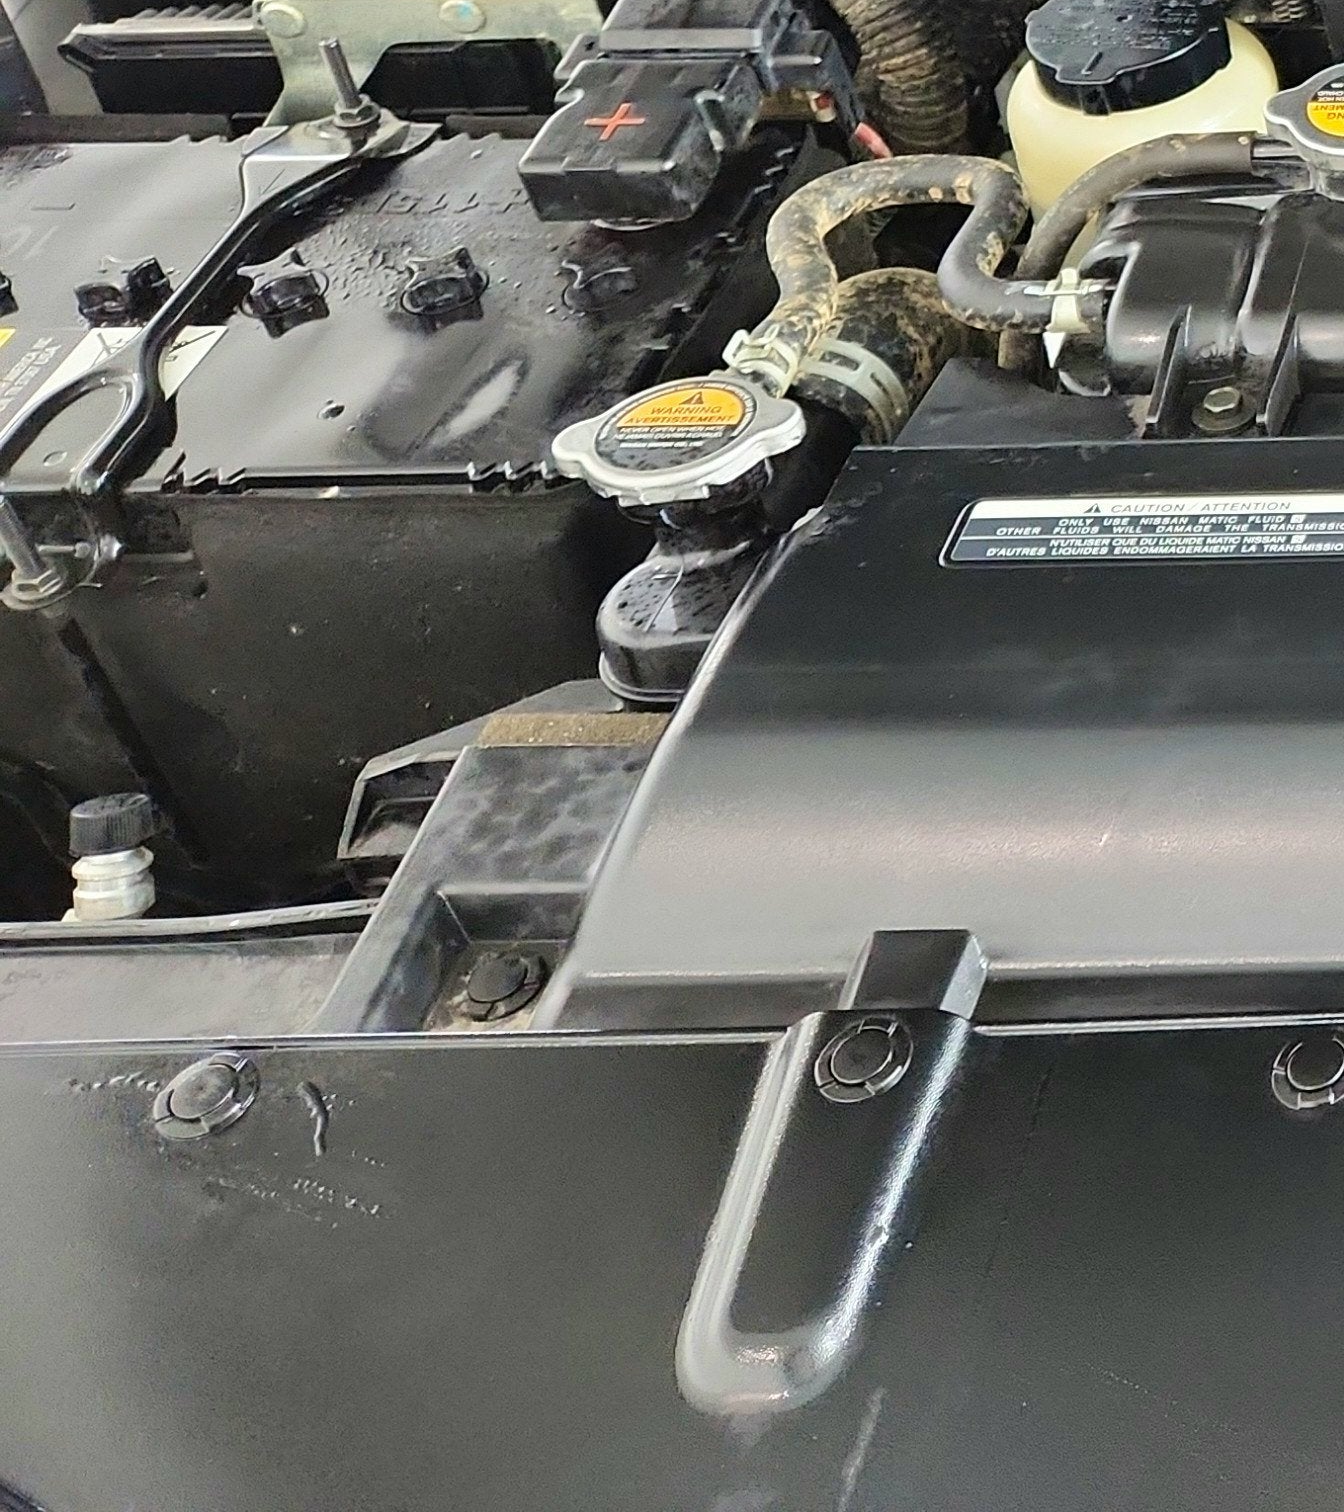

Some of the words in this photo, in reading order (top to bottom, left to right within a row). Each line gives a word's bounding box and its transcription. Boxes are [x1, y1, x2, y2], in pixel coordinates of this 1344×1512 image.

[650, 406, 722, 414] WARNING
[625, 414, 735, 424] AVERTISSEMENT
[1111, 503, 1185, 513] CAUTION
[1200, 502, 1291, 512] ATTENTION
[1058, 518, 1095, 526] ONLY
[1103, 517, 1130, 526] USE
[1139, 516, 1190, 525] NISSAN
[1197, 515, 1239, 524] MATIC
[1247, 514, 1287, 523] FLUID
[995, 527, 1042, 536] OTHER
[1052, 526, 1100, 535] FLUIDS
[1112, 525, 1143, 534] WILL
[1155, 524, 1212, 533] DAMAGE
[1223, 524, 1250, 532] THE
[1049, 538, 1111, 547] N'UTILISER
[1111, 537, 1138, 546] QUE
[1139, 537, 1157, 546] DU
[1158, 536, 1205, 546] LIQUIDE
[1205, 535, 1242, 545] MATIC
[1242, 535, 1287, 544] NISSAN
[986, 548, 1046, 557] D'AUTRES
[1051, 546, 1111, 556] LIQUIDES
[1113, 544, 1237, 555] ENDOMMAGERAIENT
[1240, 544, 1257, 553] LA
